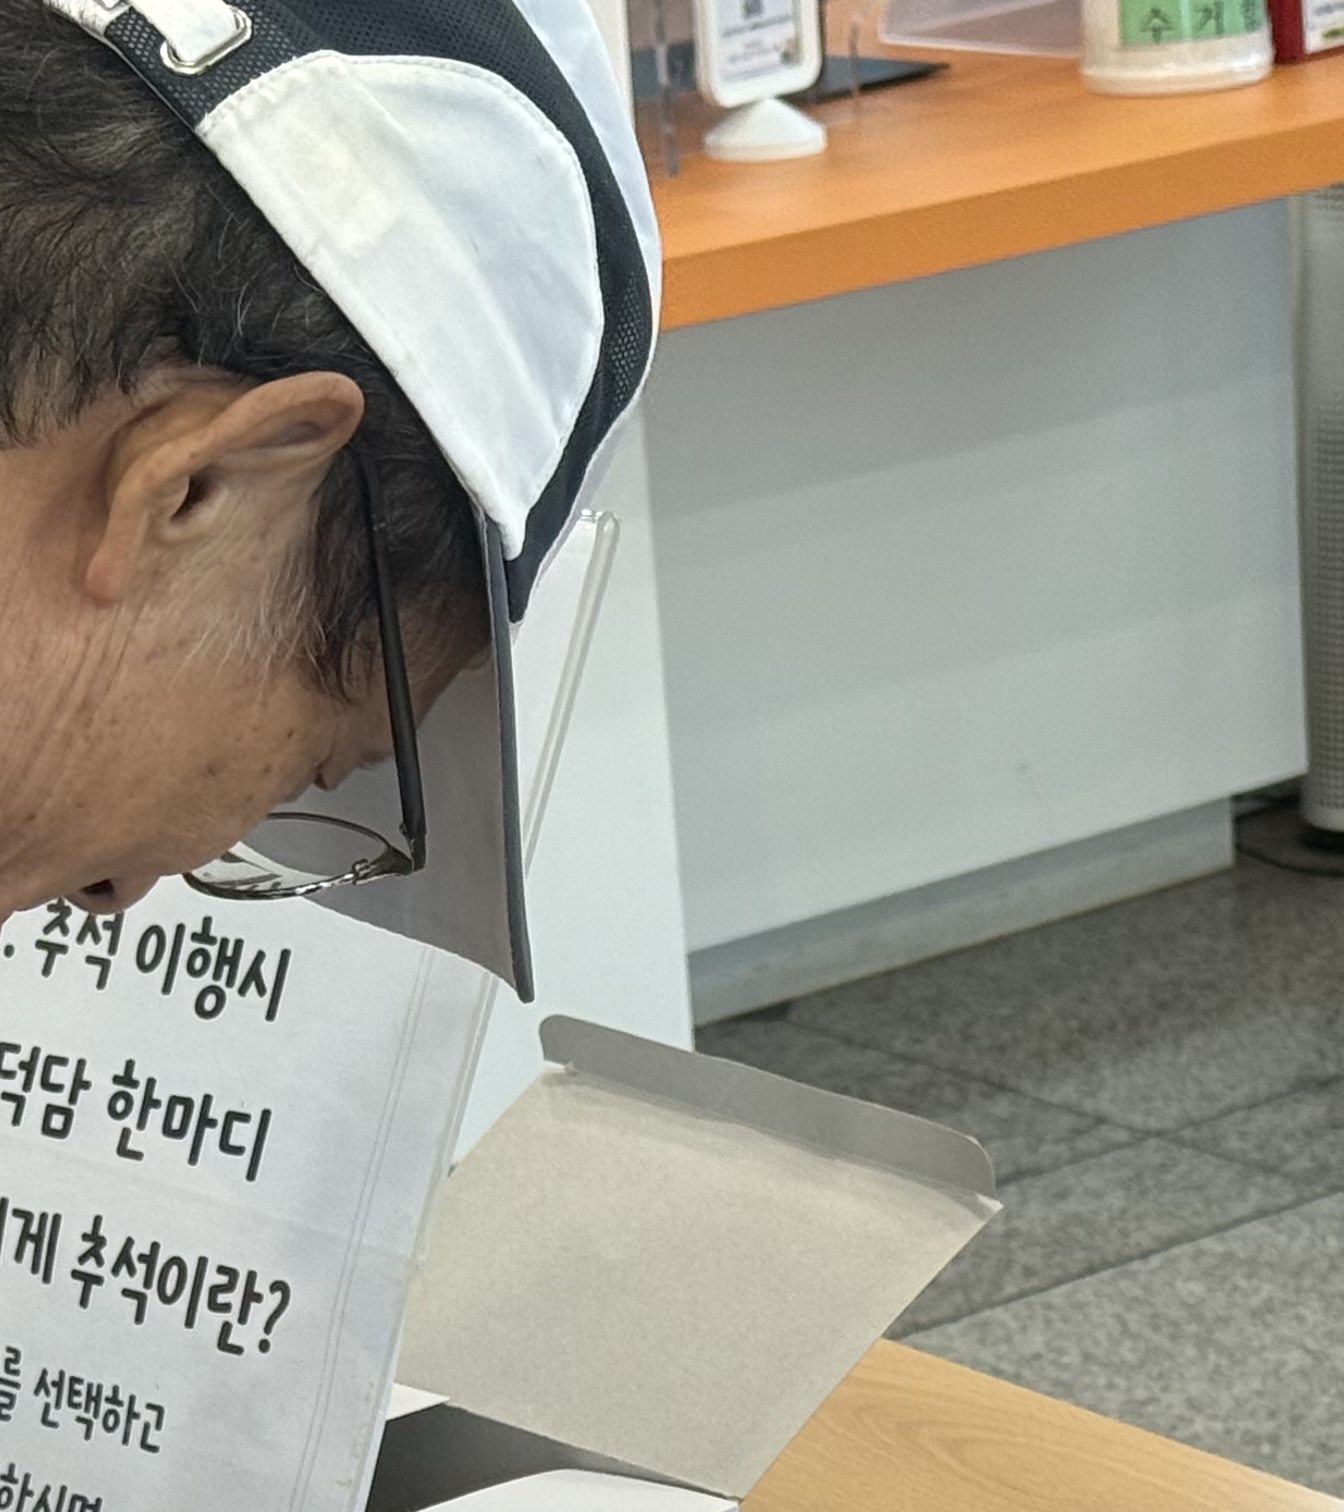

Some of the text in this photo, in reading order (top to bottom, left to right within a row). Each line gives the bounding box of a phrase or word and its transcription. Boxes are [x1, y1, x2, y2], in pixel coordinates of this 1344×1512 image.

[34, 898, 125, 991] 추석
[135, 915, 291, 1023] 이행시
[107, 1059, 272, 1182] 한마디
[70, 1214, 291, 1355] 추석이란?
[33, 1367, 166, 1453] 선택하고
